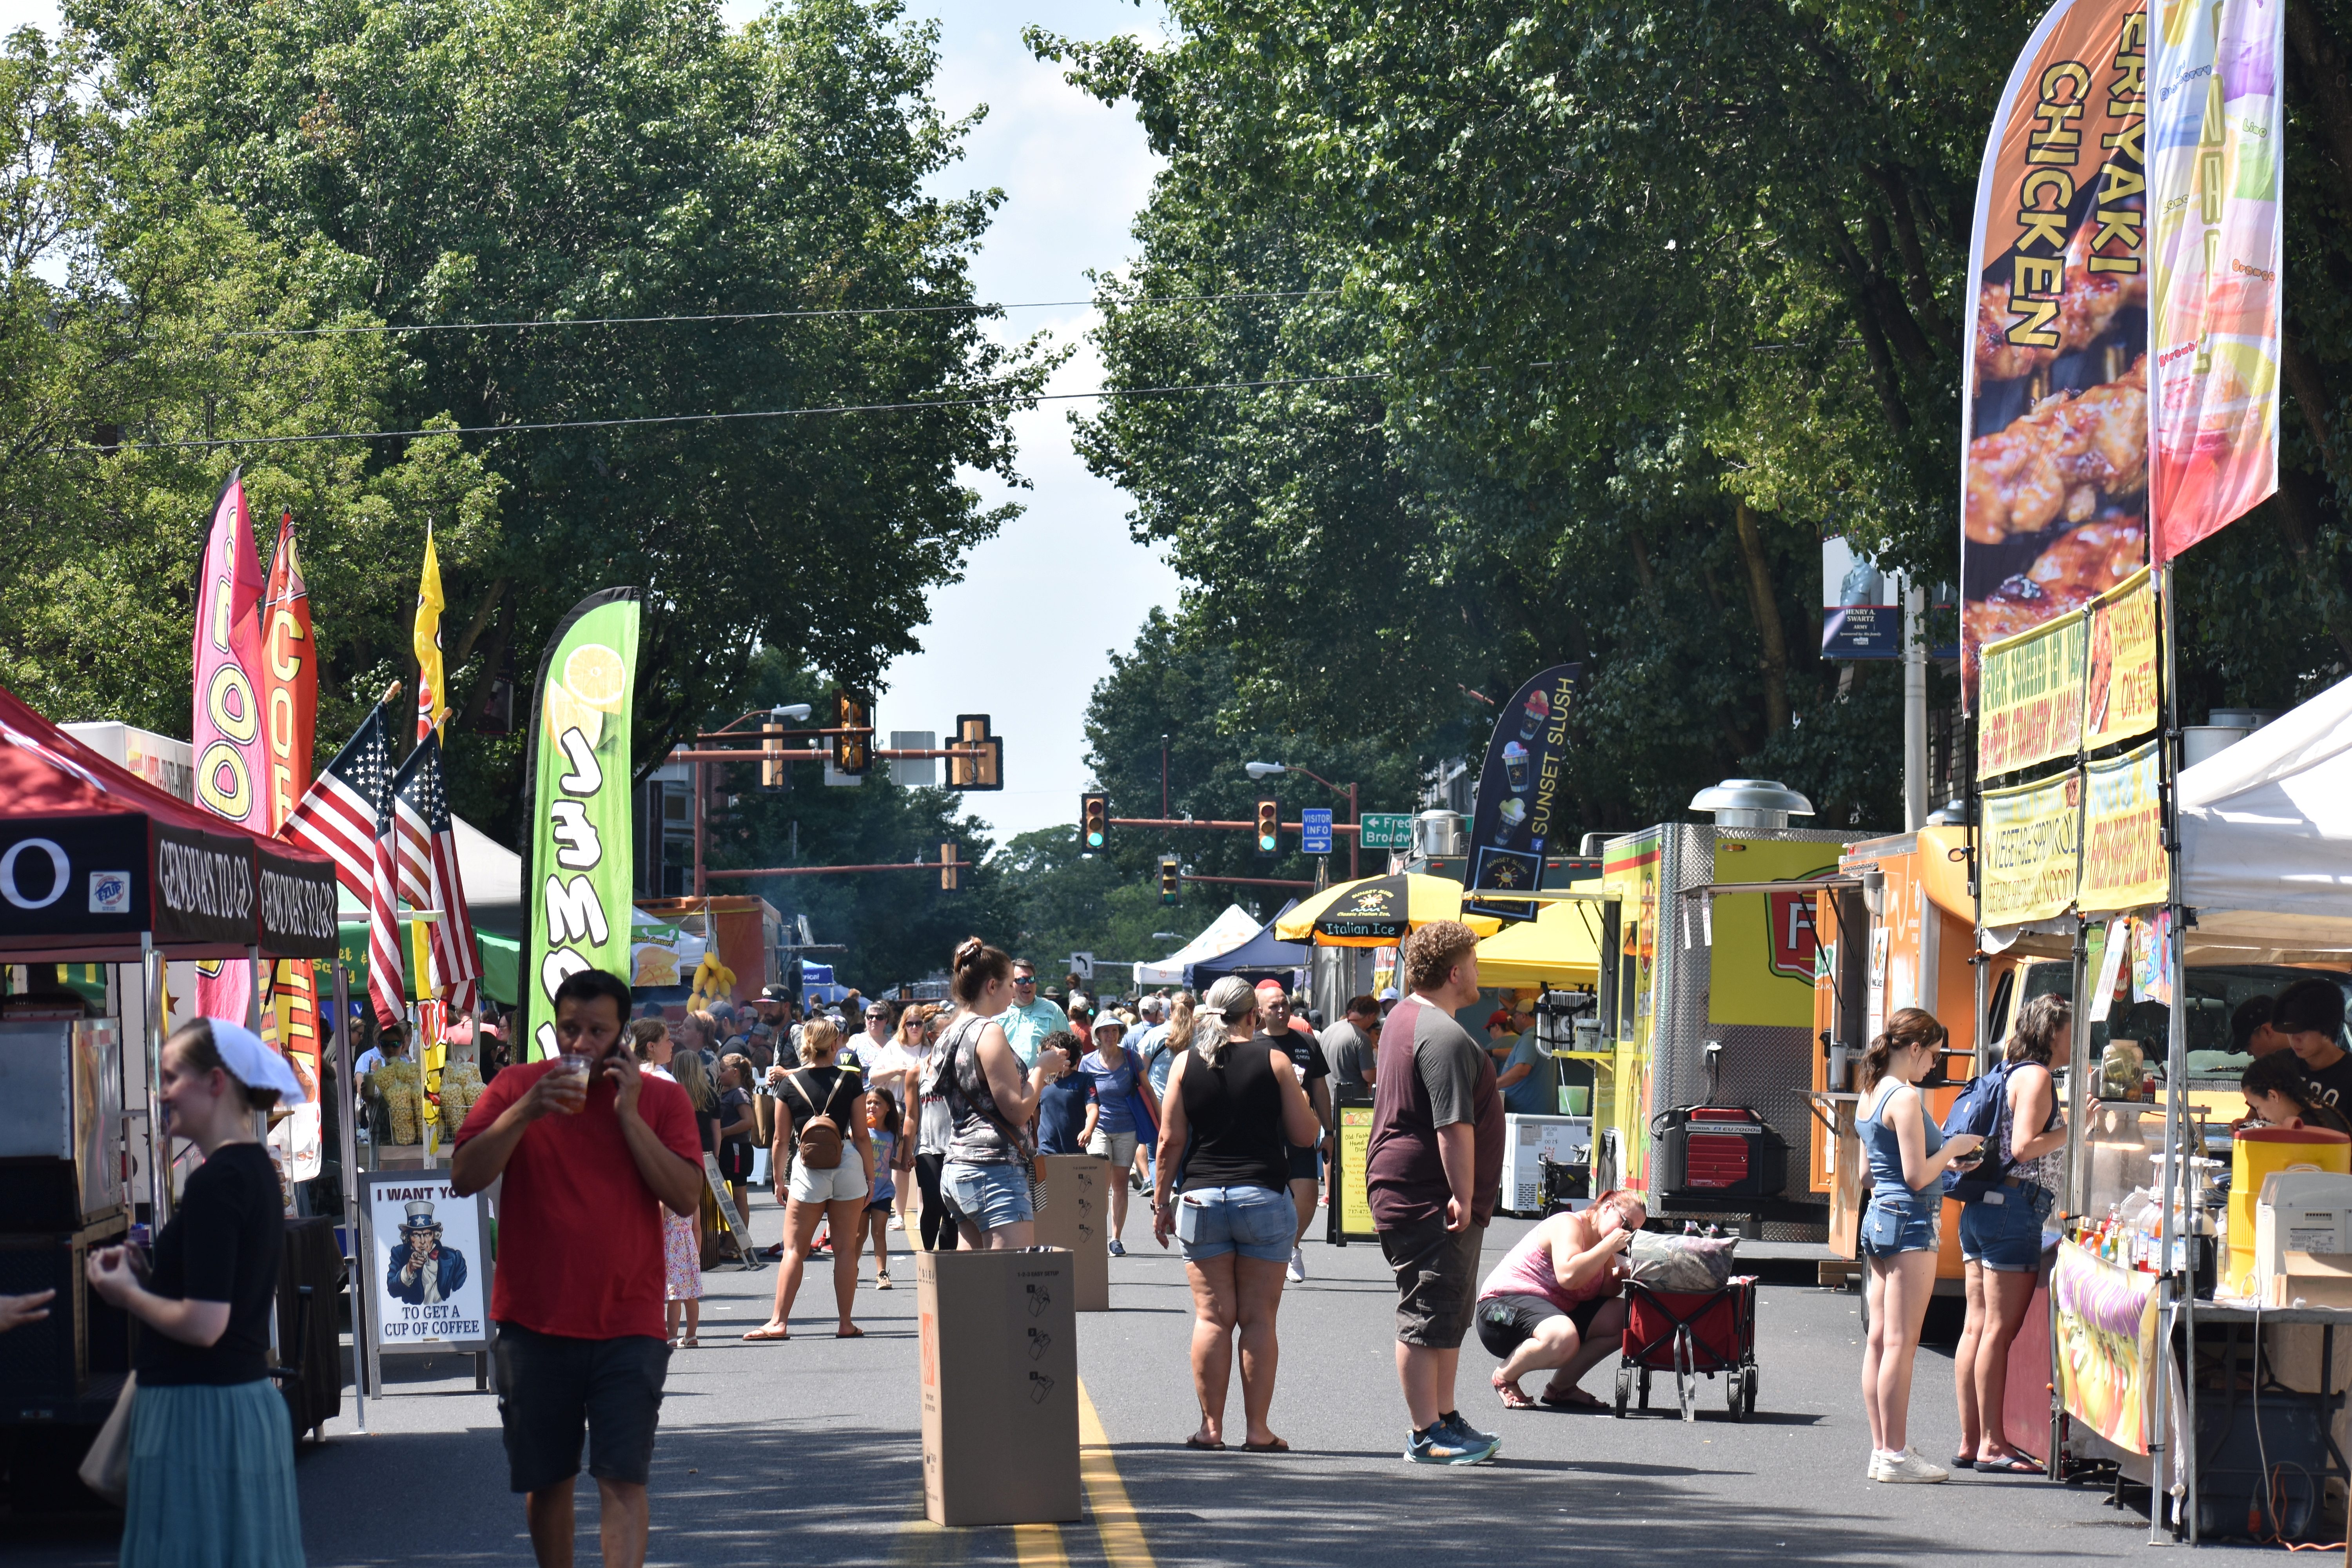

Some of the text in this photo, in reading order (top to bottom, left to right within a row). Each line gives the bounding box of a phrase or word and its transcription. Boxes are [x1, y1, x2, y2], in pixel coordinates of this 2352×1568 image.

[2242, 118, 2267, 138] Lime
[2089, 11, 2147, 274] ERIYAKI
[2005, 60, 2091, 349] CHICKEN
[2162, 194, 2189, 214] Lemo
[2232, 258, 2275, 281] Orange
[2011, 637, 2046, 703] SQUEEZED
[2122, 656, 2158, 720] ON STIC
[2010, 696, 2052, 765] STRAWBERRY
[1532, 677, 1574, 835] SUNSET SLUSH
[1304, 815, 1330, 823] VISITOR
[1307, 826, 1328, 834] INFO
[1995, 825, 2031, 868] VEGETABLE
[2089, 820, 2111, 890] FRESH
[1487, 857, 1528, 875] SUNSET SLUSH
[215, 854, 233, 918] TO
[234, 856, 253, 919] GO
[1352, 889, 1377, 898] SUNSET
[1985, 881, 2011, 913] VEGETABLE
[2042, 868, 2077, 902] NOODL
[304, 880, 320, 938] TO
[320, 882, 334, 938] GO
[1490, 902, 1522, 911] GETTYSBURG
[1326, 921, 1395, 935] Italian Ice
[650, 936, 675, 947] dessert!
[840, 1053, 852, 1065] W
[377, 1186, 459, 1201] I WANT YO
[403, 1305, 460, 1319] TO GET A
[385, 1320, 479, 1336] CUP OF COFFEE
